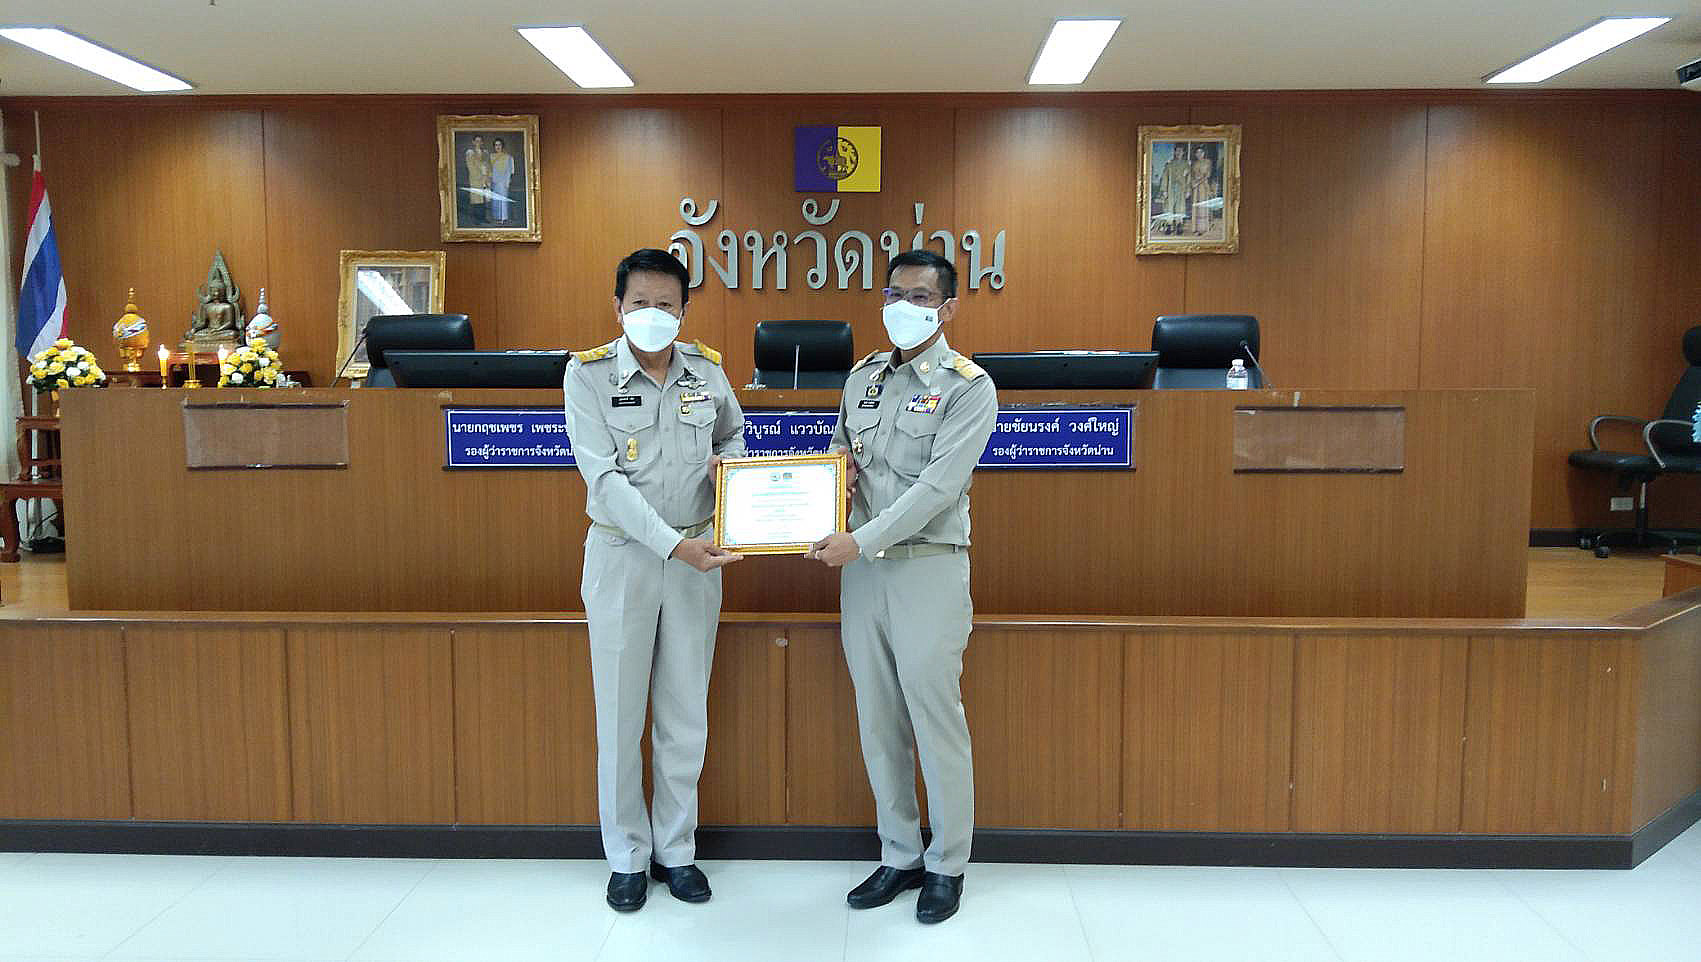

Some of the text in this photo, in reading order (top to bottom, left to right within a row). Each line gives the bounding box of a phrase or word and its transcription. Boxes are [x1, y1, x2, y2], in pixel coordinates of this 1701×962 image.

[1069, 416, 1120, 436] วงศ์ใหญ่
[992, 443, 1114, 459] รองผู้ว่าราชการจังหวัดน่าน
